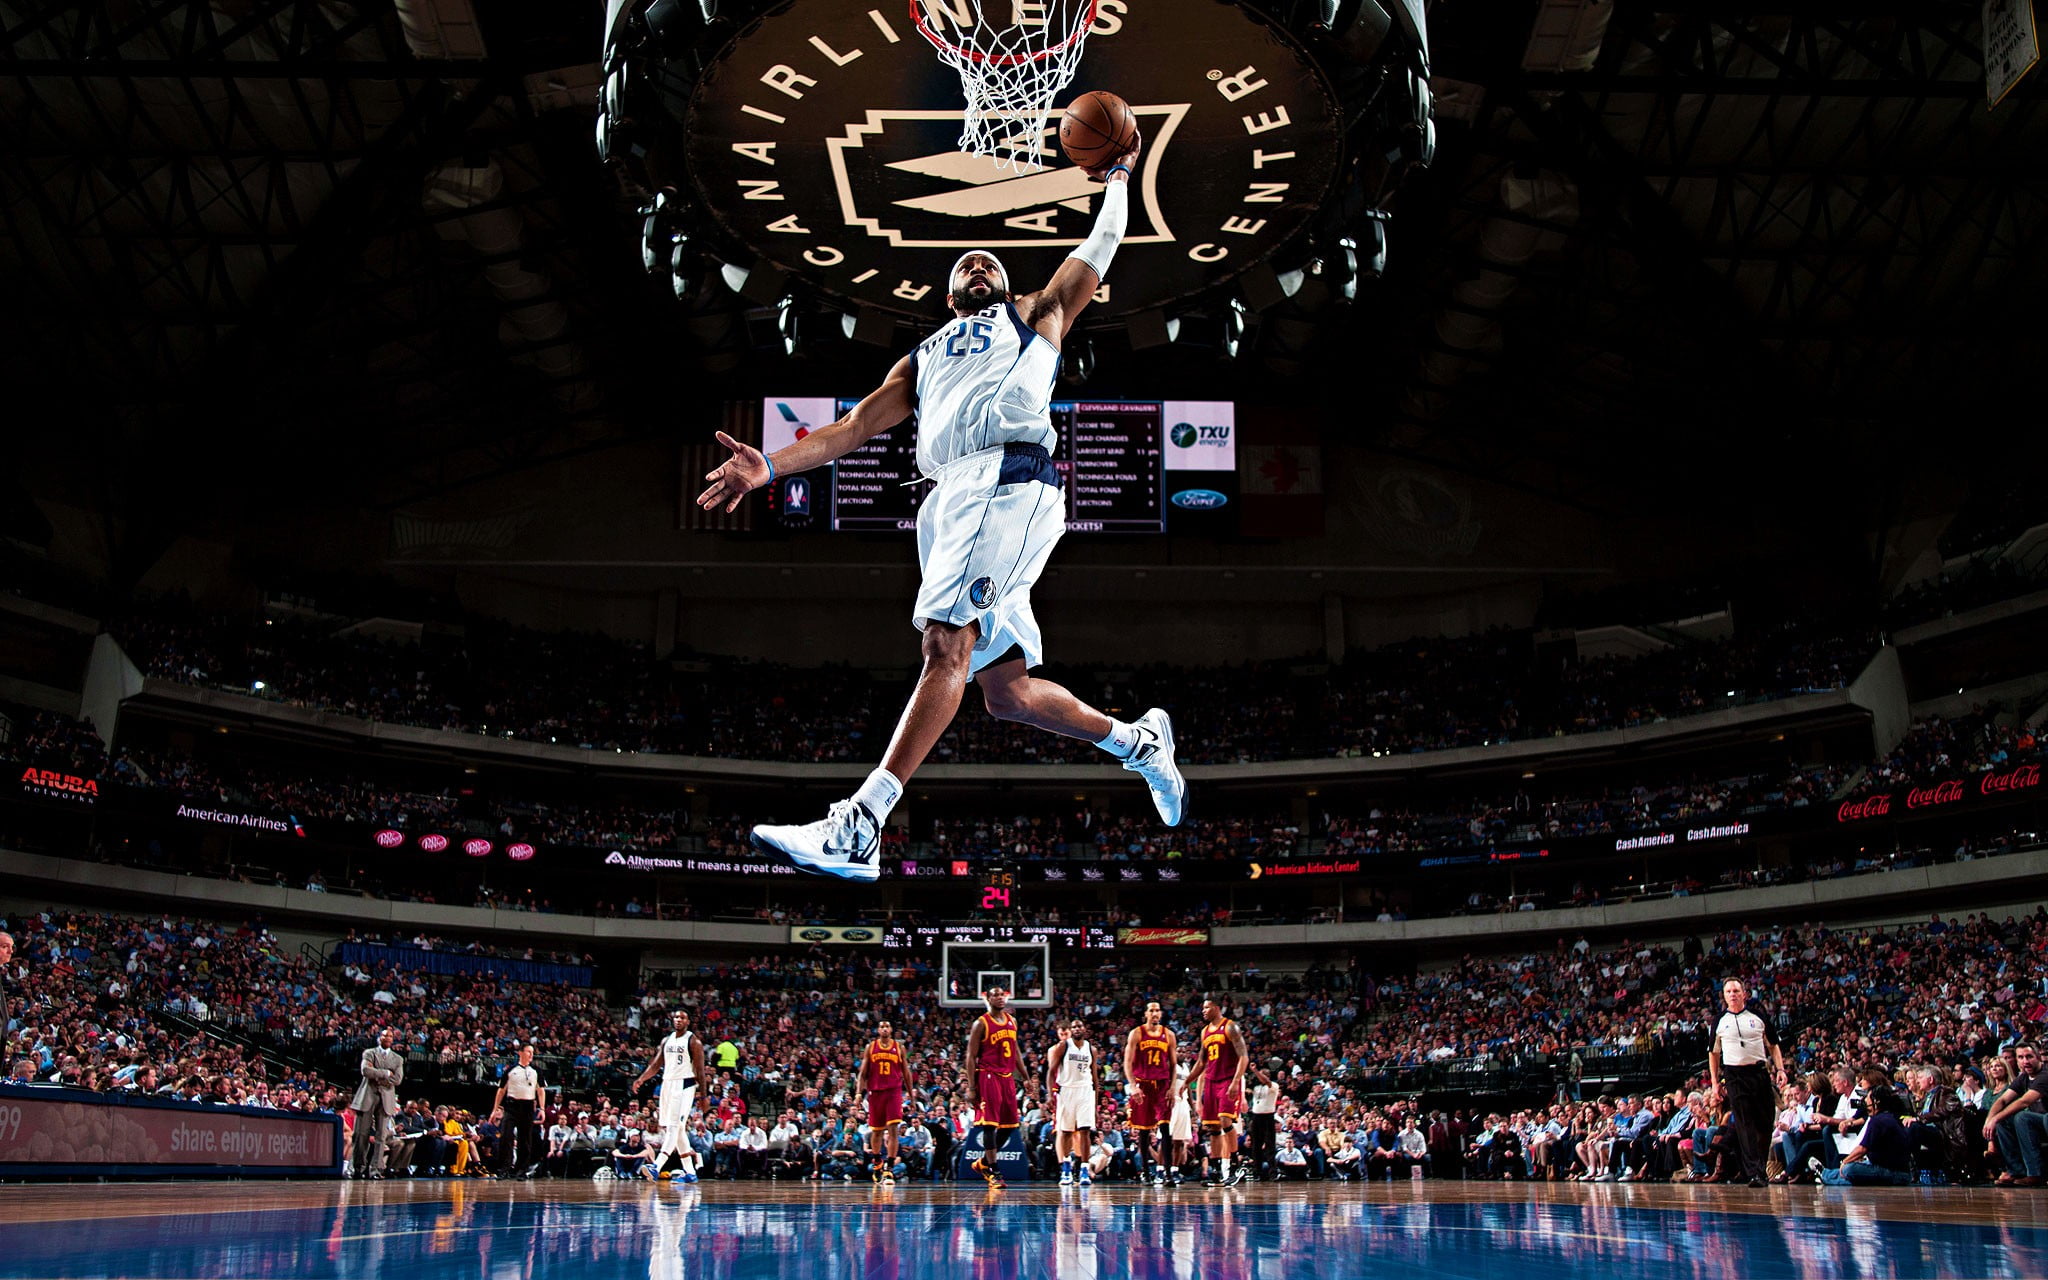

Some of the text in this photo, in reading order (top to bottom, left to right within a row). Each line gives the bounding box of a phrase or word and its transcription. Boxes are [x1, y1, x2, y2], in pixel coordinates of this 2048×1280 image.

[946, 321, 992, 357] 25
[1199, 426, 1230, 438] TXU
[1199, 440, 1228, 448] energy
[1182, 493, 1217, 506] Ford
[21, 767, 99, 796] ARUBA
[24, 785, 94, 804] networks
[177, 804, 288, 832] American Airlines
[627, 855, 682, 868] Albertsons
[688, 859, 695, 869] It
[698, 862, 731, 872] means
[734, 864, 740, 872] a
[743, 862, 769, 875] great
[905, 866, 945, 875] MODIA
[1265, 860, 1359, 875] to American Airlines Center!
[983, 887, 1009, 908] 24
[926, 937, 933, 945] 5
[1066, 937, 1073, 946] 2
[1125, 929, 1187, 944] Budweiser
[1002, 1041, 1011, 1057] 3
[1207, 1044, 1219, 1060] 33
[677, 1054, 683, 1065] 9
[1147, 1050, 1160, 1066] 14
[879, 1062, 890, 1075] 13
[171, 1121, 309, 1160] share. enjoy. repeat.
[965, 1150, 1022, 1161] SOUWEST
